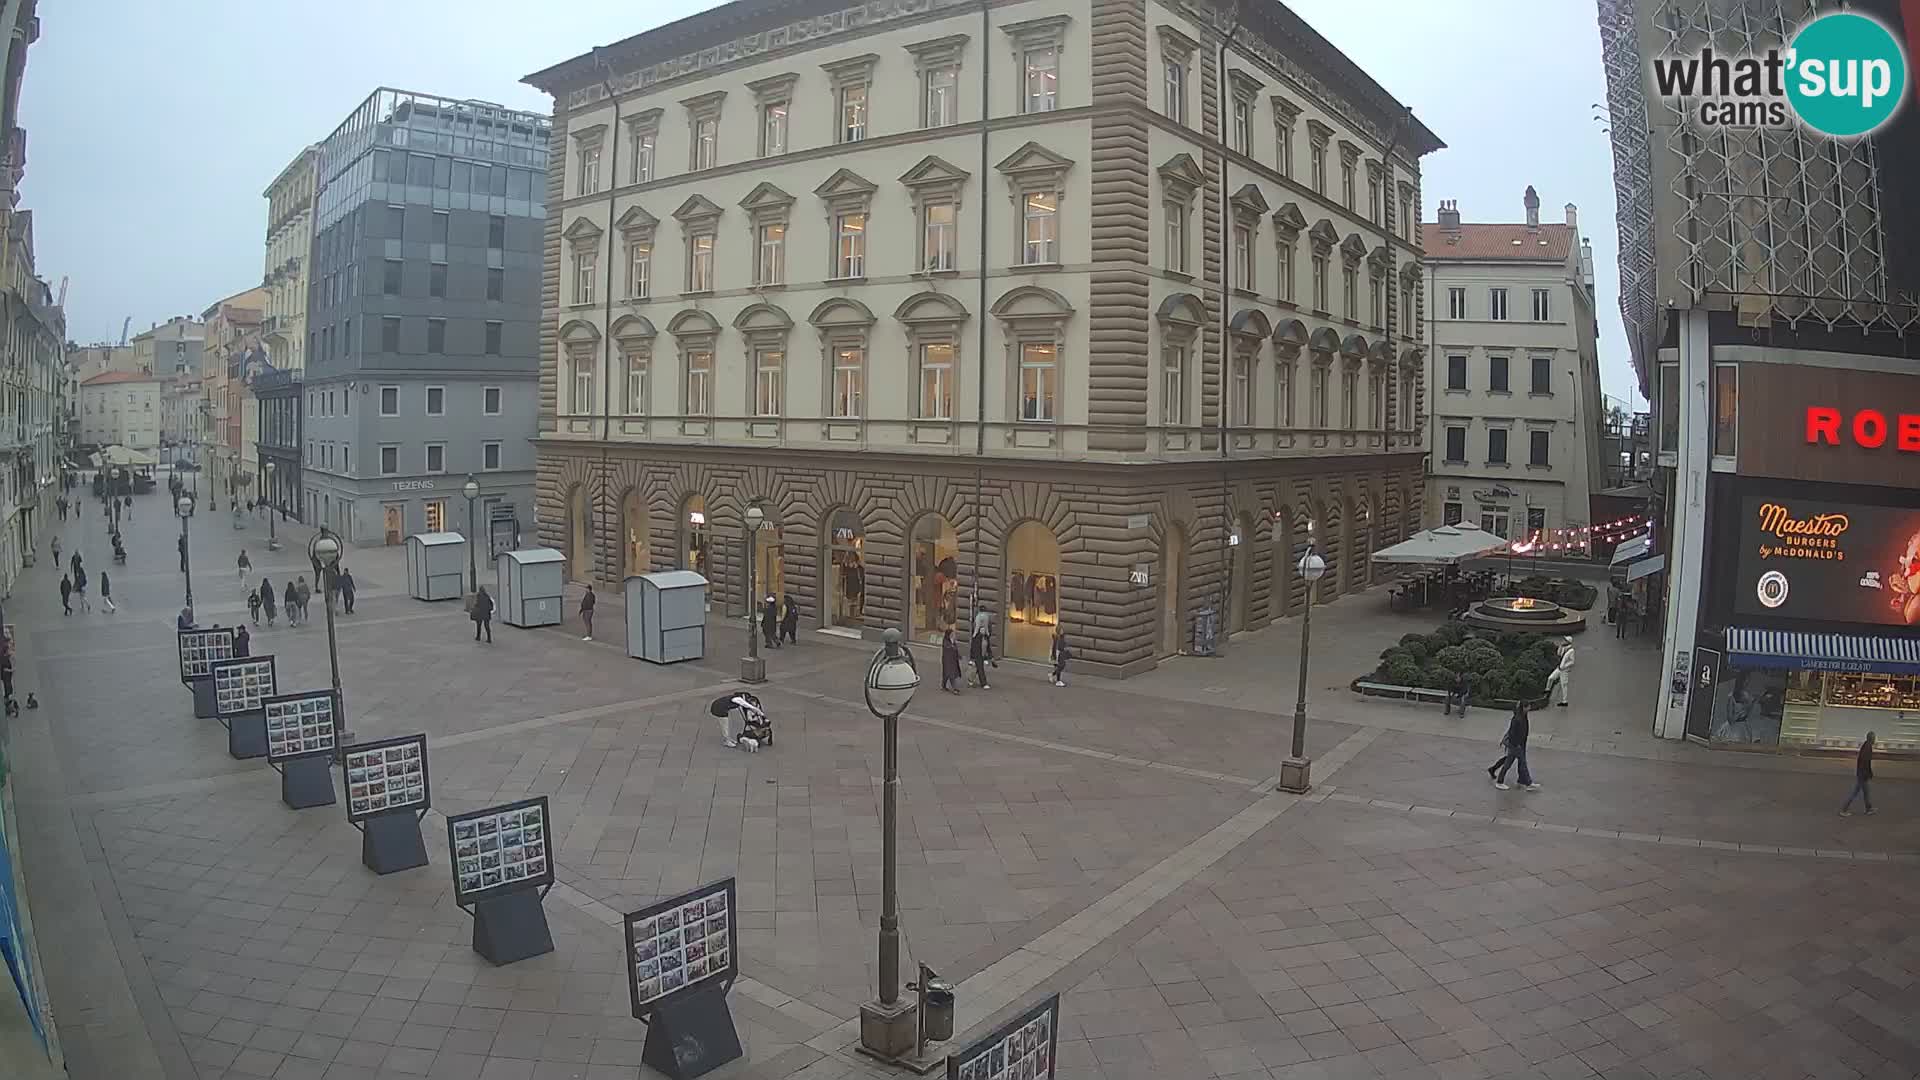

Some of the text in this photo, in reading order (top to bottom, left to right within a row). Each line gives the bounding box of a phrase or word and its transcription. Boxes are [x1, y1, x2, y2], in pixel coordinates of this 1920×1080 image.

[392, 480, 434, 490] TEZENIS
[1759, 503, 1848, 537] Maestro
[1786, 536, 1836, 549] BURGERS
[1759, 544, 1844, 561] by McDONALD'S
